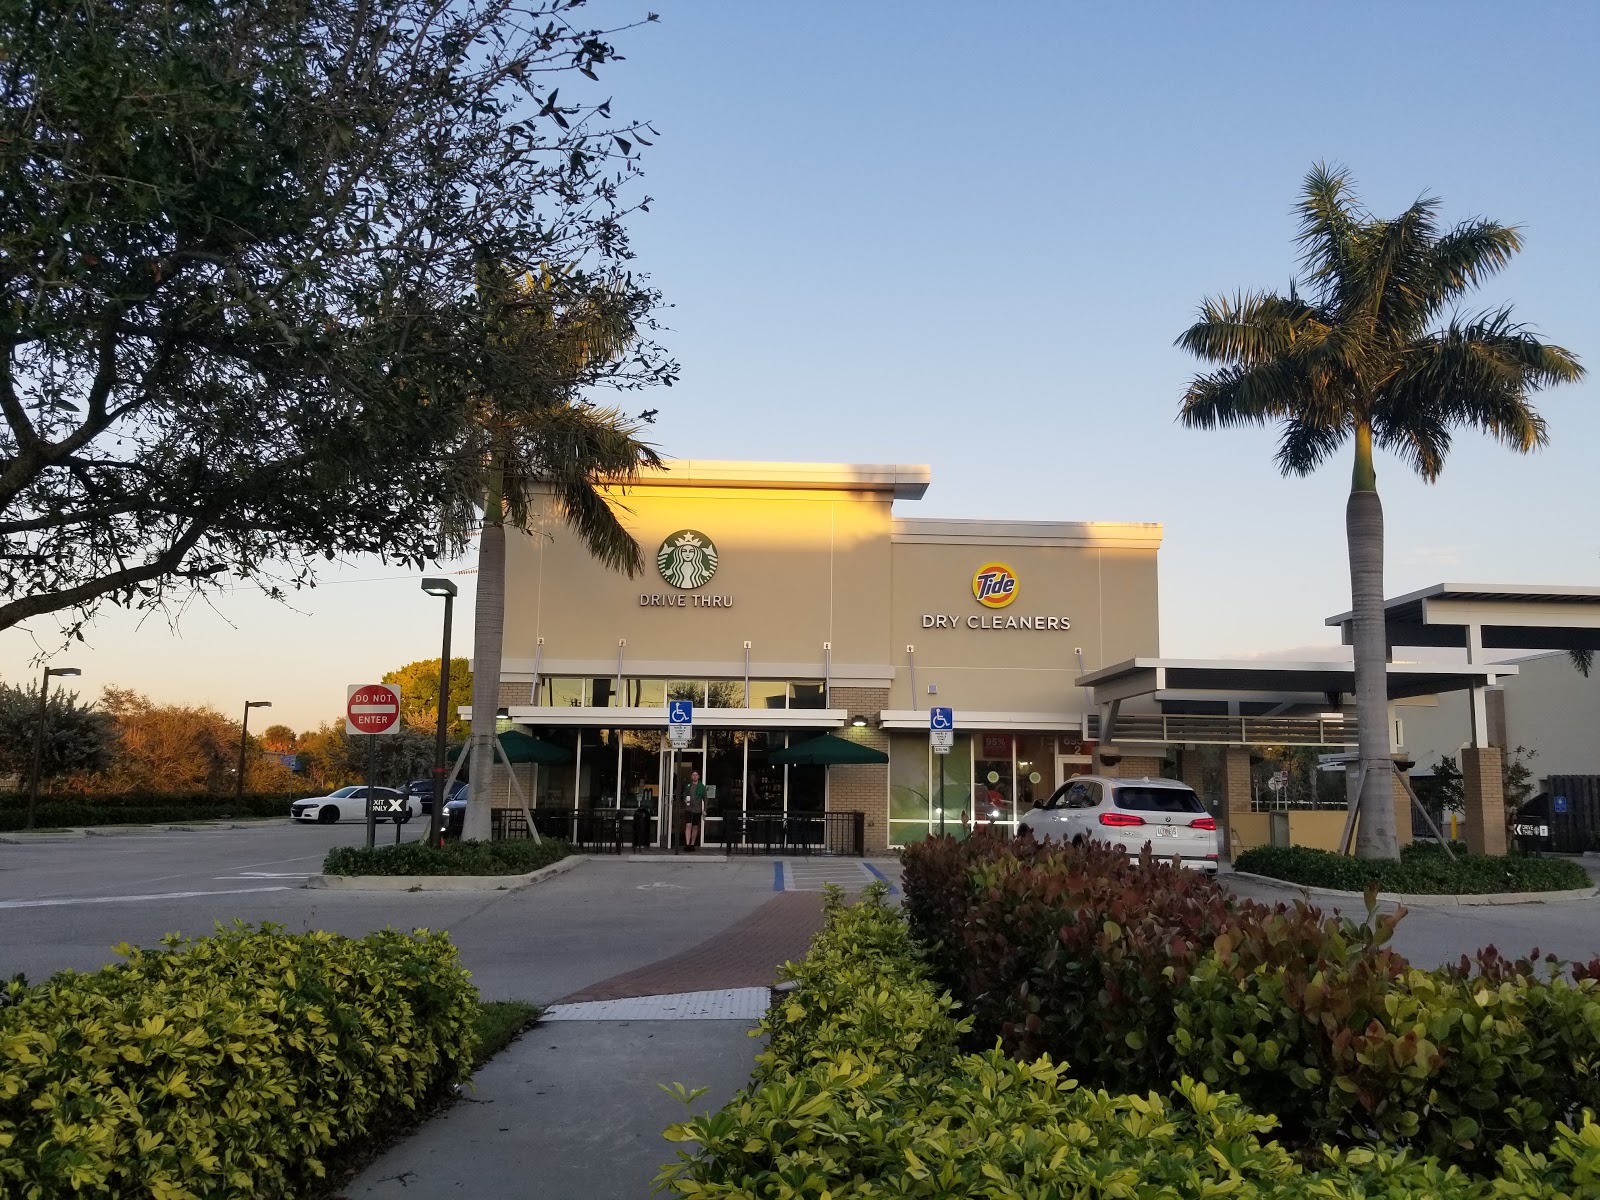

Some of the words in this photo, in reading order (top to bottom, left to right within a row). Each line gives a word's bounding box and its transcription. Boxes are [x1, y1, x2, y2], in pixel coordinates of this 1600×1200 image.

[976, 572, 1015, 600] Tide
[639, 593, 686, 607] DRIVE
[692, 594, 733, 608] THRU
[921, 614, 960, 629] DRY
[967, 615, 1071, 630] CLEANERS
[355, 694, 369, 703] DO
[372, 694, 392, 702] NOT
[358, 716, 388, 724] ENTER
[985, 737, 1006, 746] 95%
[1074, 745, 1082, 755] 2
